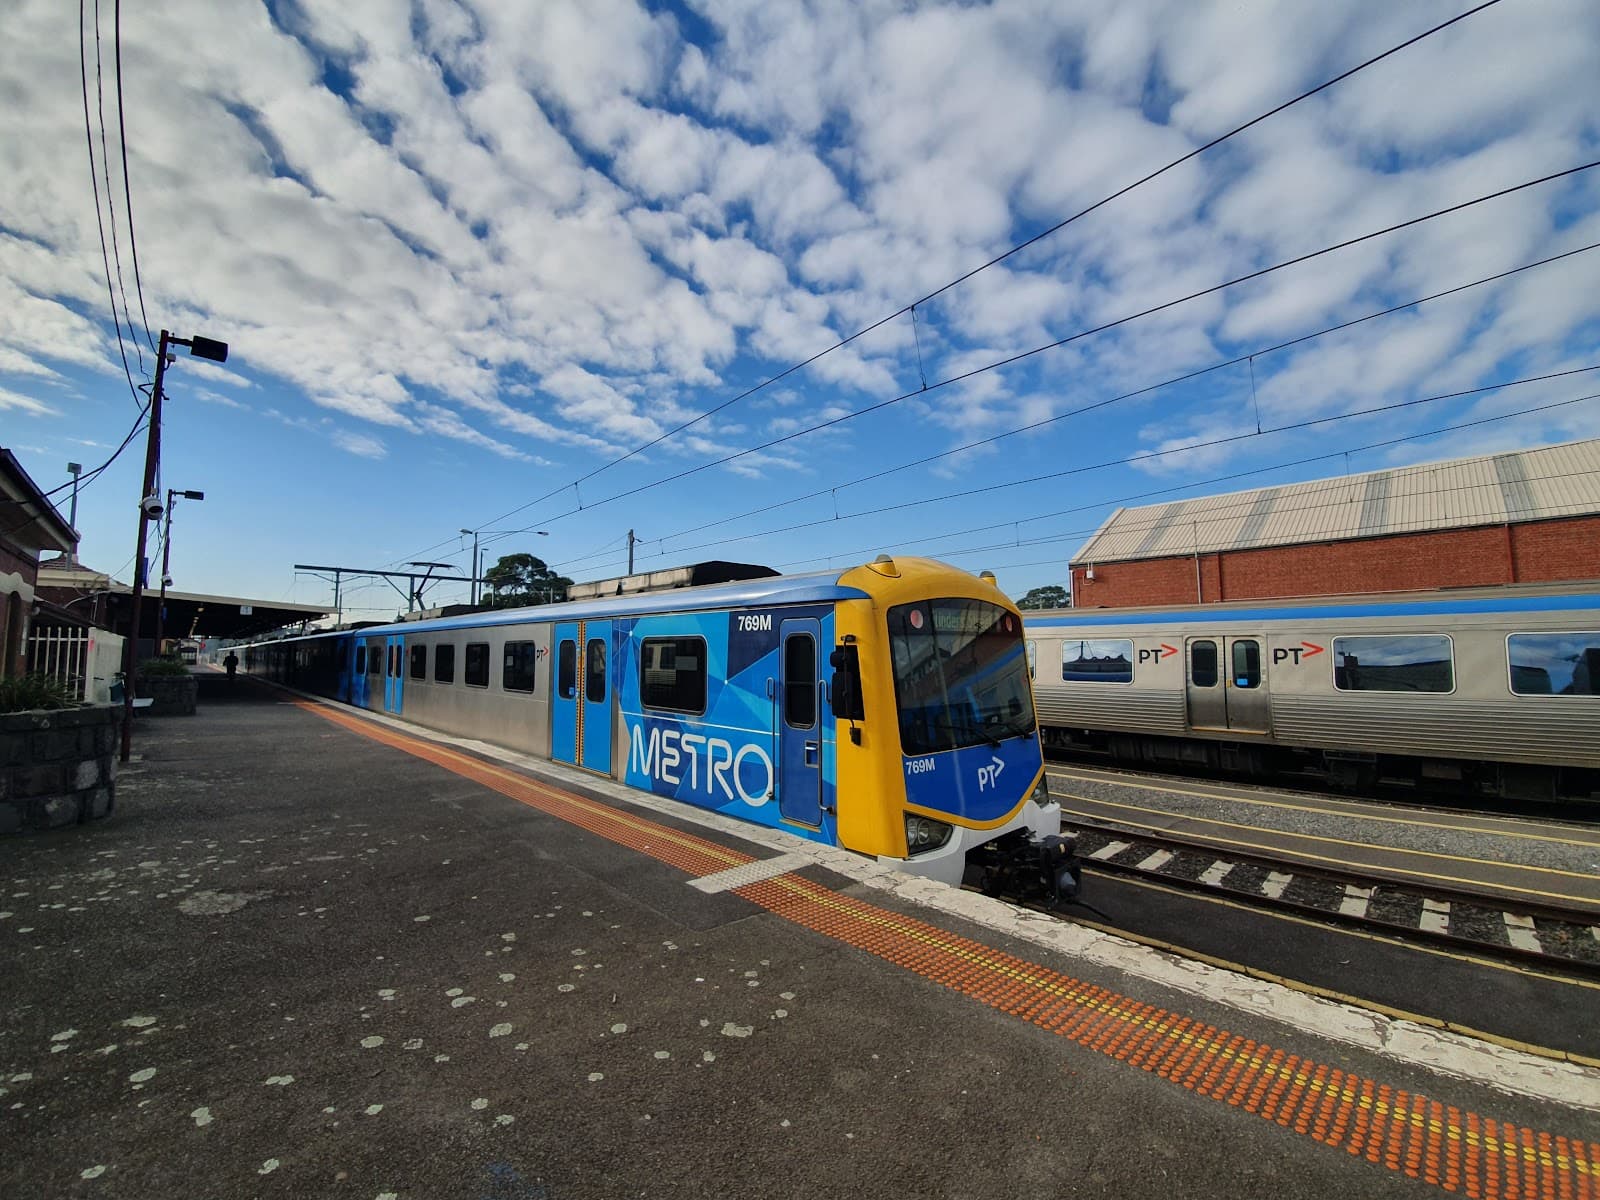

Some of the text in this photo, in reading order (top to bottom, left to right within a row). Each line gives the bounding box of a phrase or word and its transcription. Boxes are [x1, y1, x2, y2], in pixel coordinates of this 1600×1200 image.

[737, 614, 772, 632] 769M
[932, 611, 965, 628] linders
[632, 723, 774, 807] METRO
[905, 757, 936, 775] 769M
